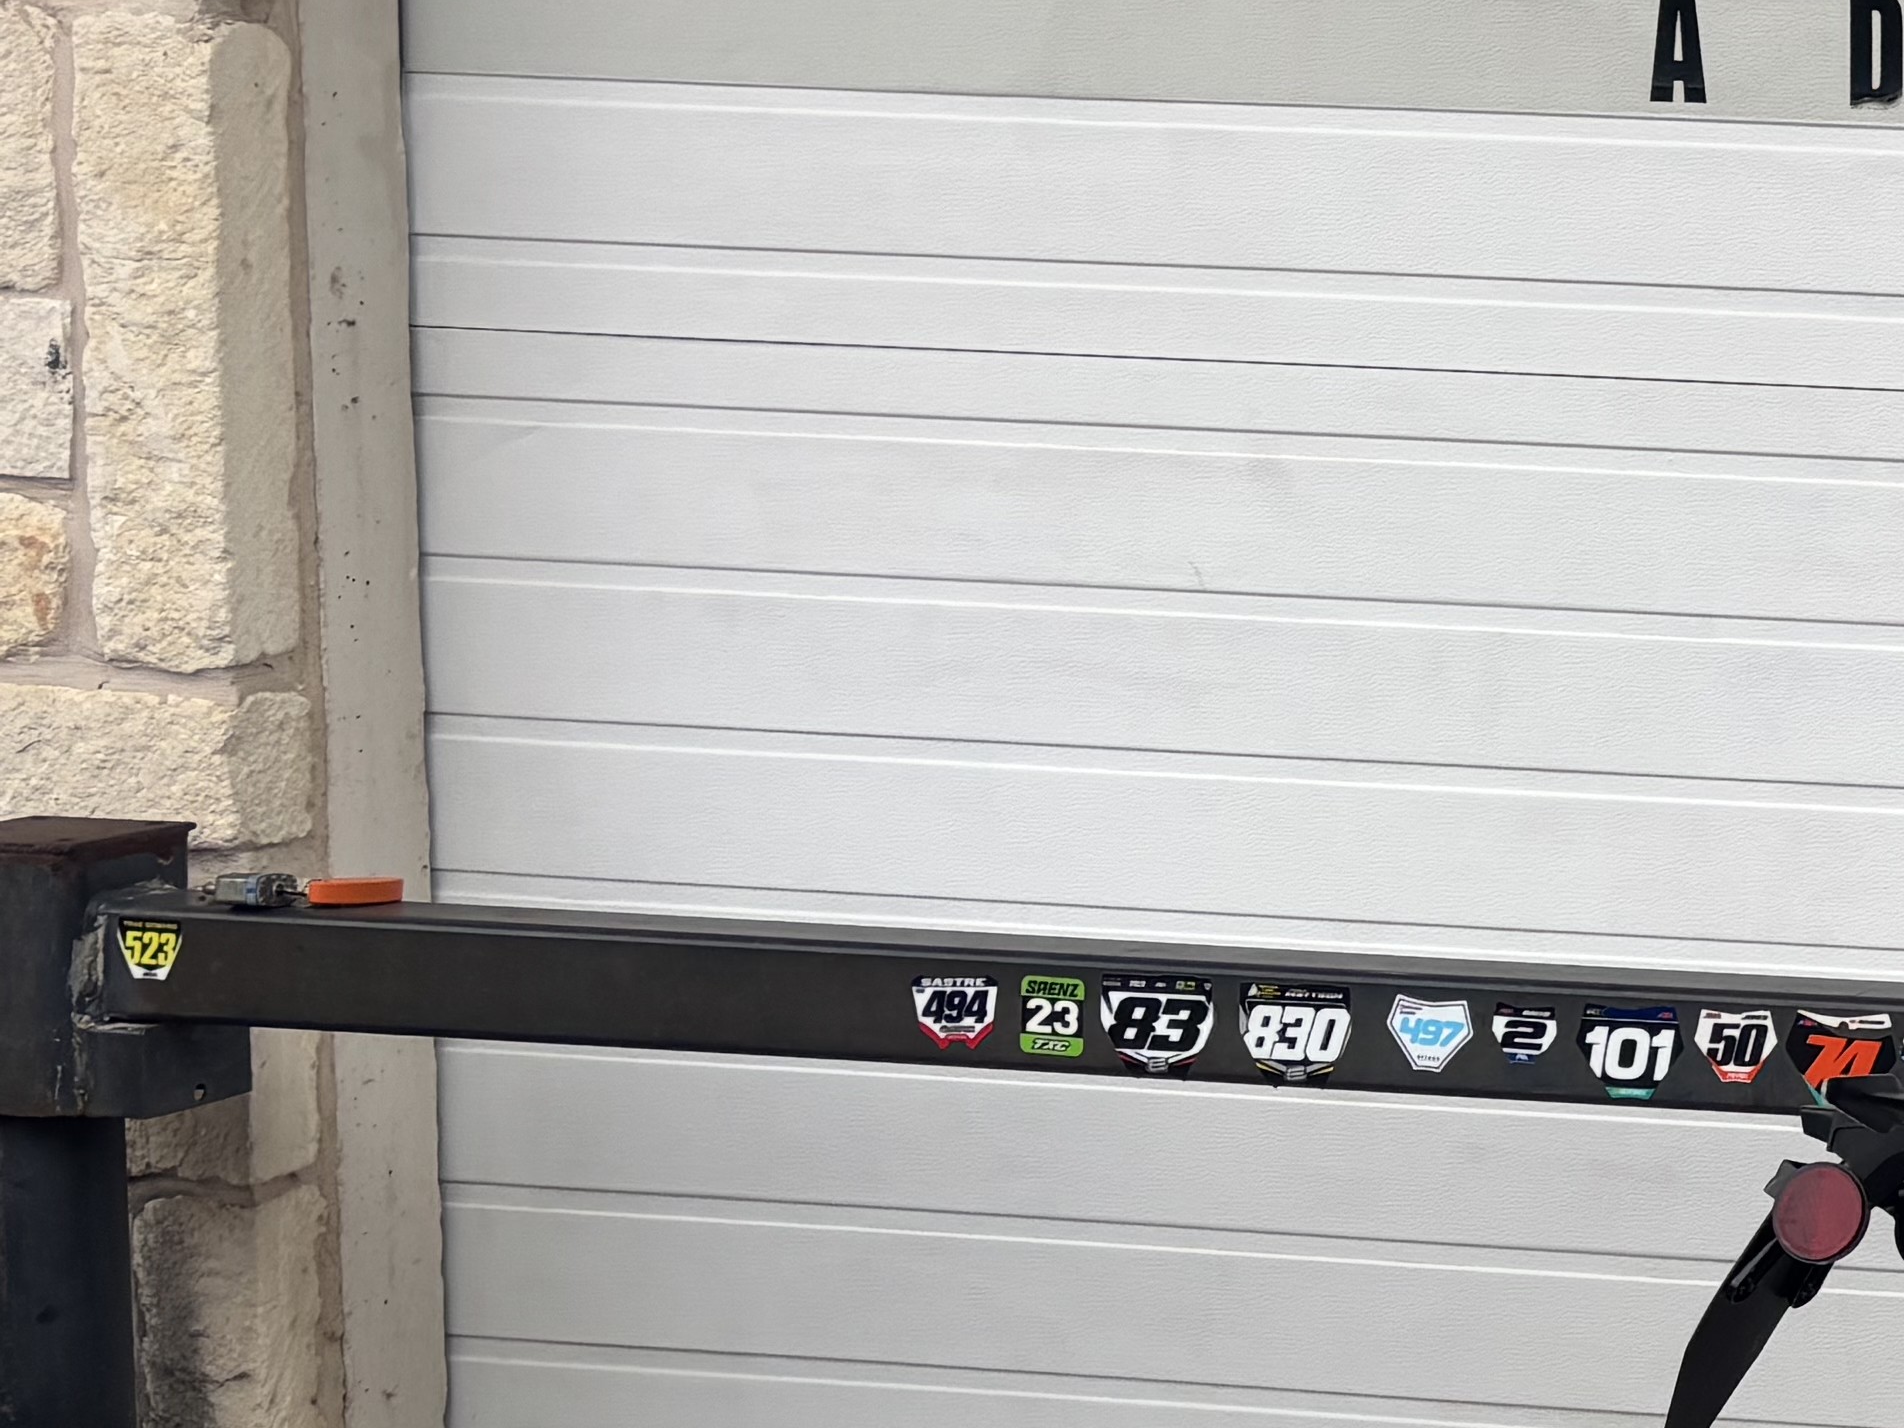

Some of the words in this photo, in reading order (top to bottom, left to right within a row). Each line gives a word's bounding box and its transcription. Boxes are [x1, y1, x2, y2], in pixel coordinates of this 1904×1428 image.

[125, 930, 176, 965] 523
[922, 990, 989, 1024] 494
[1026, 998, 1079, 1035] 23
[1107, 996, 1209, 1052] 83
[1244, 1004, 1350, 1062] 830
[1400, 1017, 1465, 1047] 497
[1500, 1019, 1547, 1051] 2
[1706, 1023, 1769, 1067] 50
[1585, 1025, 1676, 1081] 101
